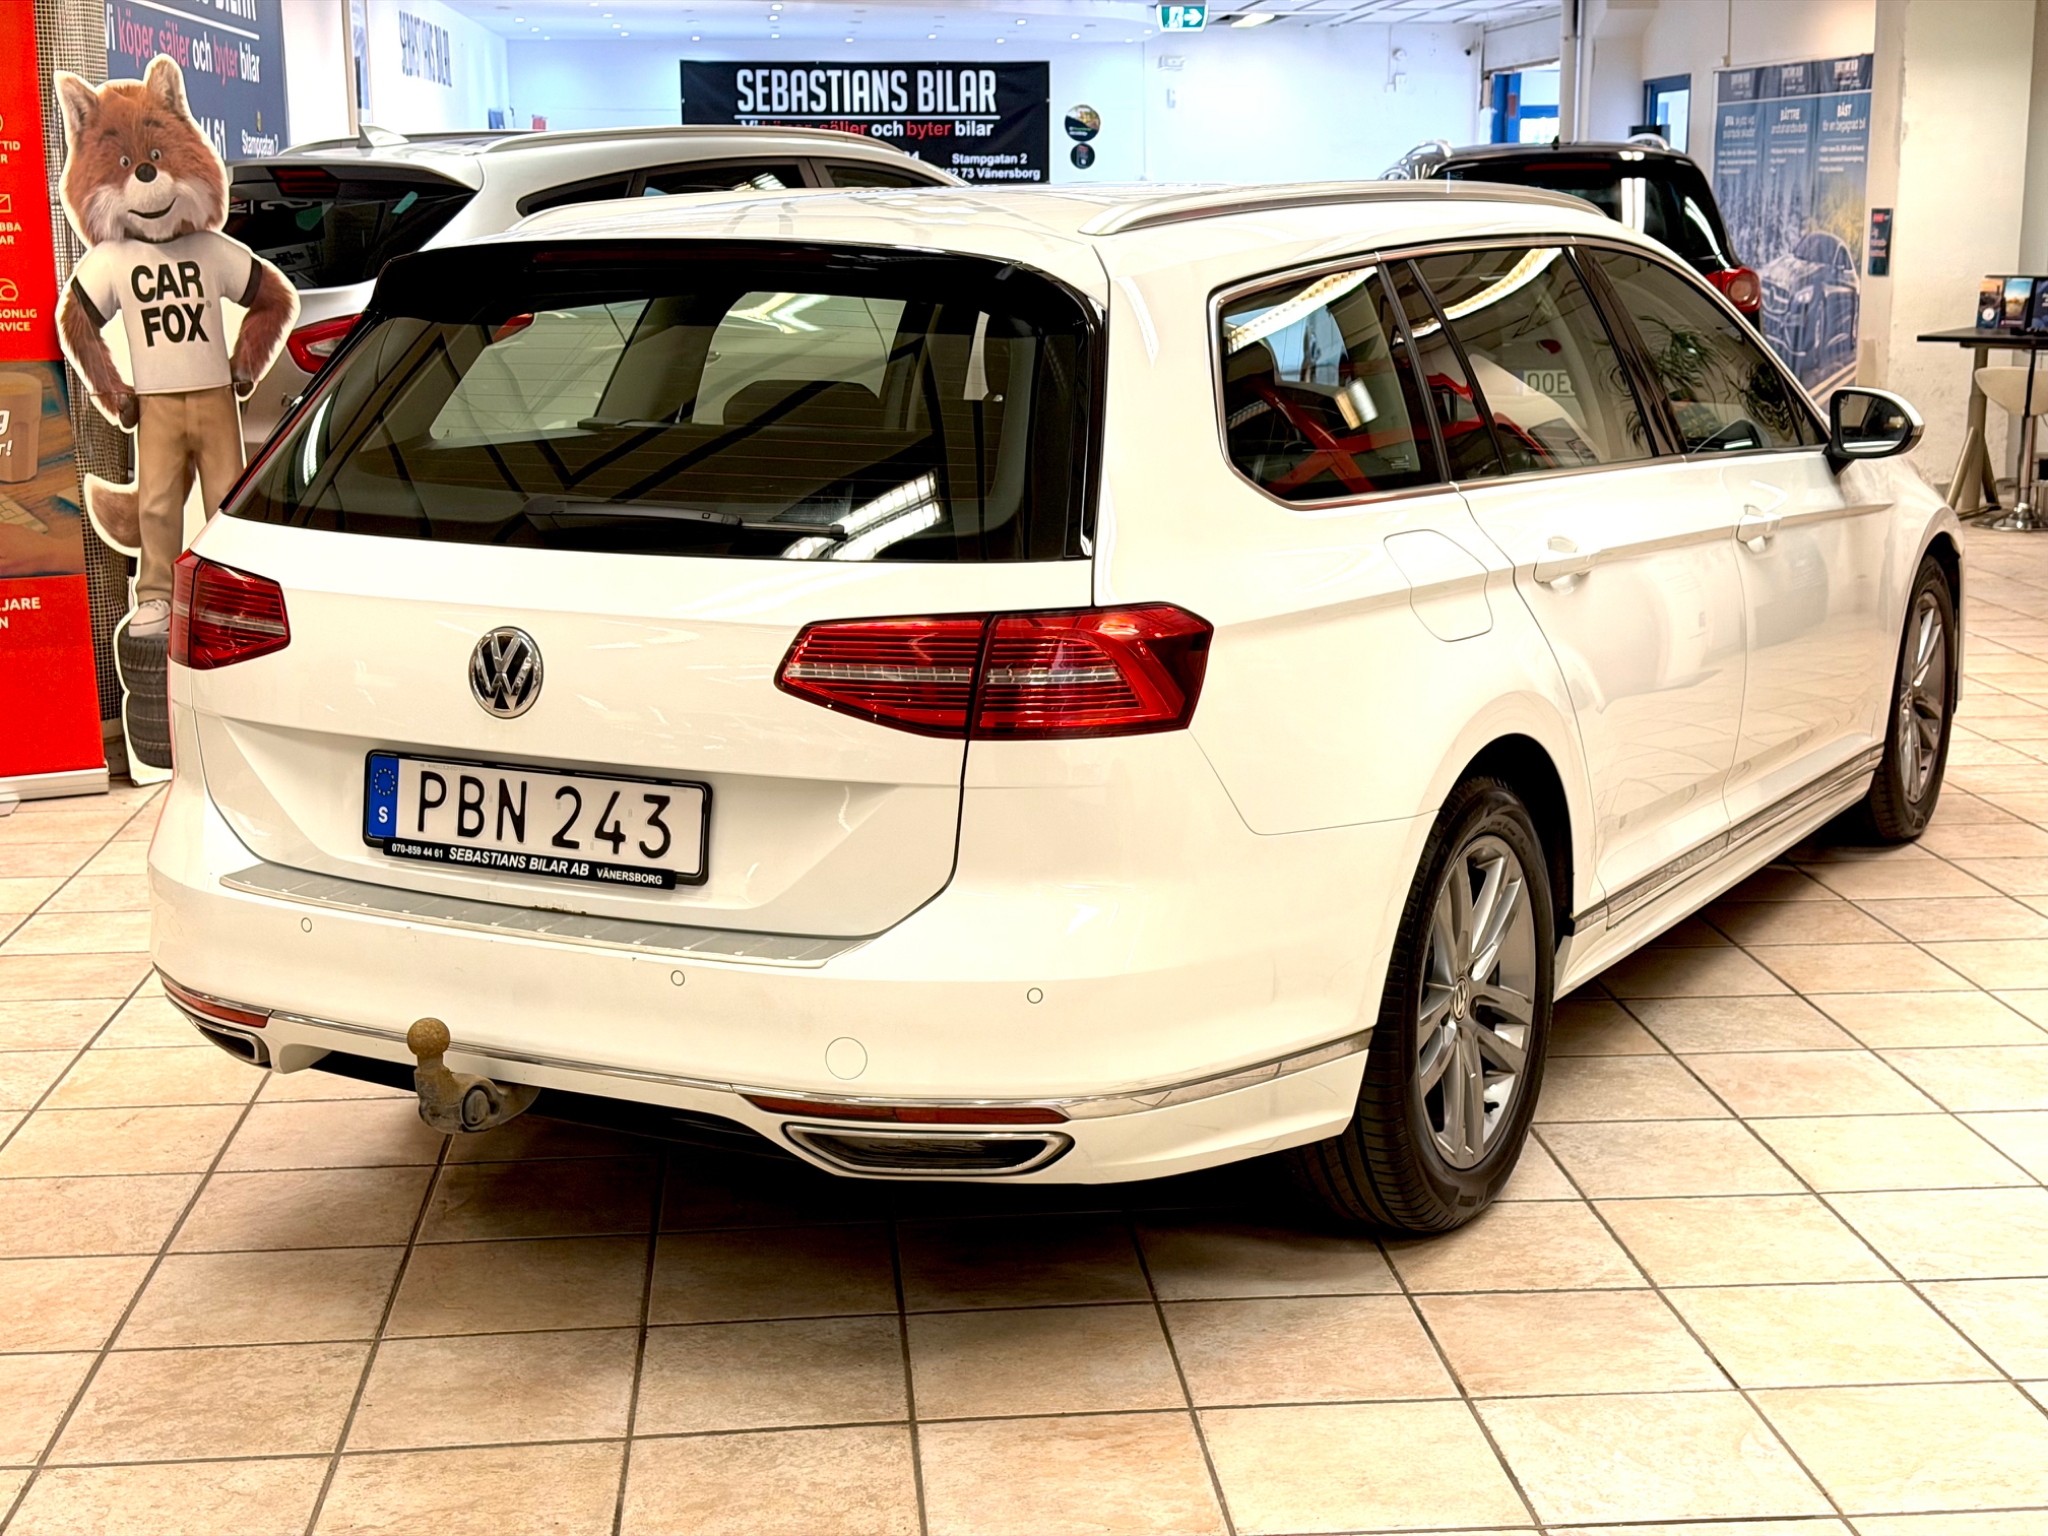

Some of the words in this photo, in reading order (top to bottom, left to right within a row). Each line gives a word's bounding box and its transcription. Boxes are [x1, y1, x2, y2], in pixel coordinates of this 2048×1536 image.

[159, 20, 190, 68] säljer
[192, 31, 213, 73] och
[213, 34, 239, 87] byter
[239, 41, 260, 83] bilar
[736, 68, 909, 113] SEBASTIANS
[916, 69, 997, 113] BILAR
[871, 121, 904, 136] och
[906, 121, 952, 140] byter
[954, 121, 994, 137] bilar
[951, 152, 1017, 166] Stampgatan
[1020, 153, 1028, 165] 2
[961, 167, 975, 179] 73
[976, 166, 1041, 181] Vänersborg
[131, 261, 205, 303] CAR
[140, 303, 210, 348] FOX
[0, 596, 41, 612] JARE
[377, 806, 389, 824] S
[417, 770, 528, 843] PBN
[551, 785, 672, 859] 243
[391, 842, 422, 856] 070-859
[422, 846, 433, 858] 44
[433, 848, 444, 859] 61
[448, 847, 527, 870] SEBASTIANS
[528, 856, 569, 875] BILAR
[569, 861, 590, 877] AB
[596, 867, 663, 886] VÄNERSBORG
